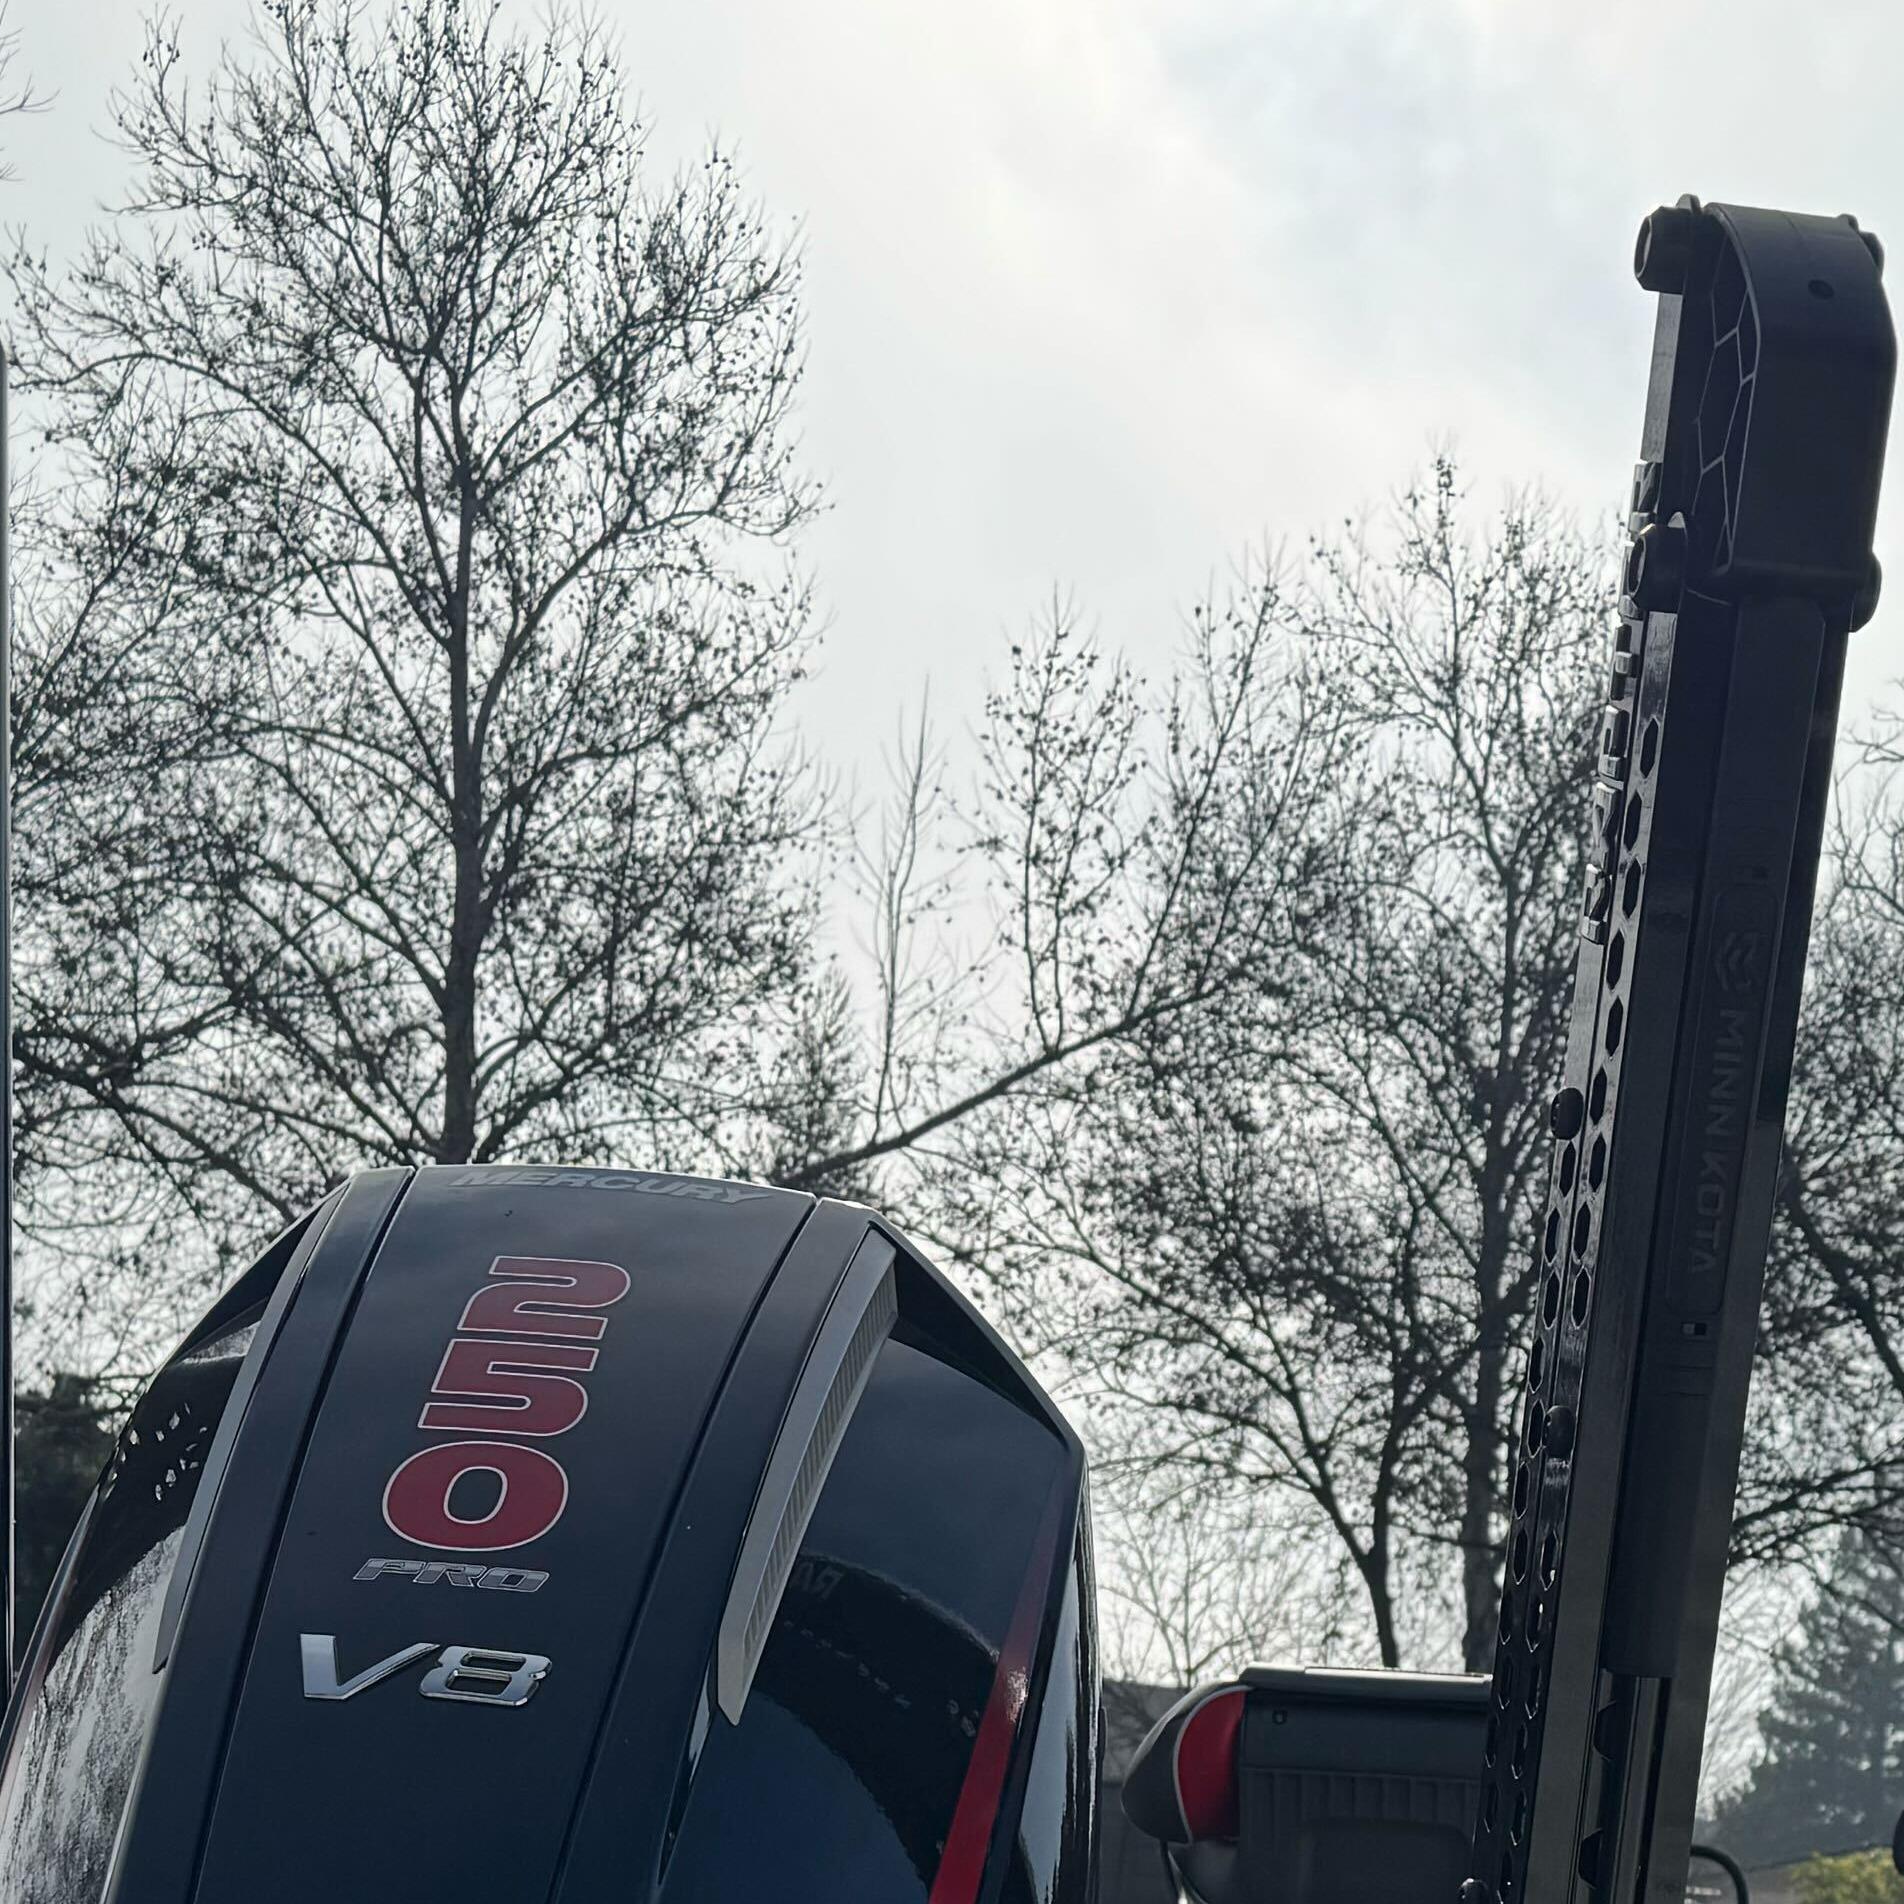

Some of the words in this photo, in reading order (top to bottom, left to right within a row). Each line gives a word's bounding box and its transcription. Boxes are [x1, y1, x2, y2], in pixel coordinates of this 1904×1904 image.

[1704, 1008, 1745, 1138] MINN
[448, 1171, 772, 1204] MERCURY
[1686, 1150, 1729, 1273] KOTA
[381, 1255, 632, 1552] 250
[353, 1557, 551, 1593] PRO
[300, 1633, 553, 1706] V8
